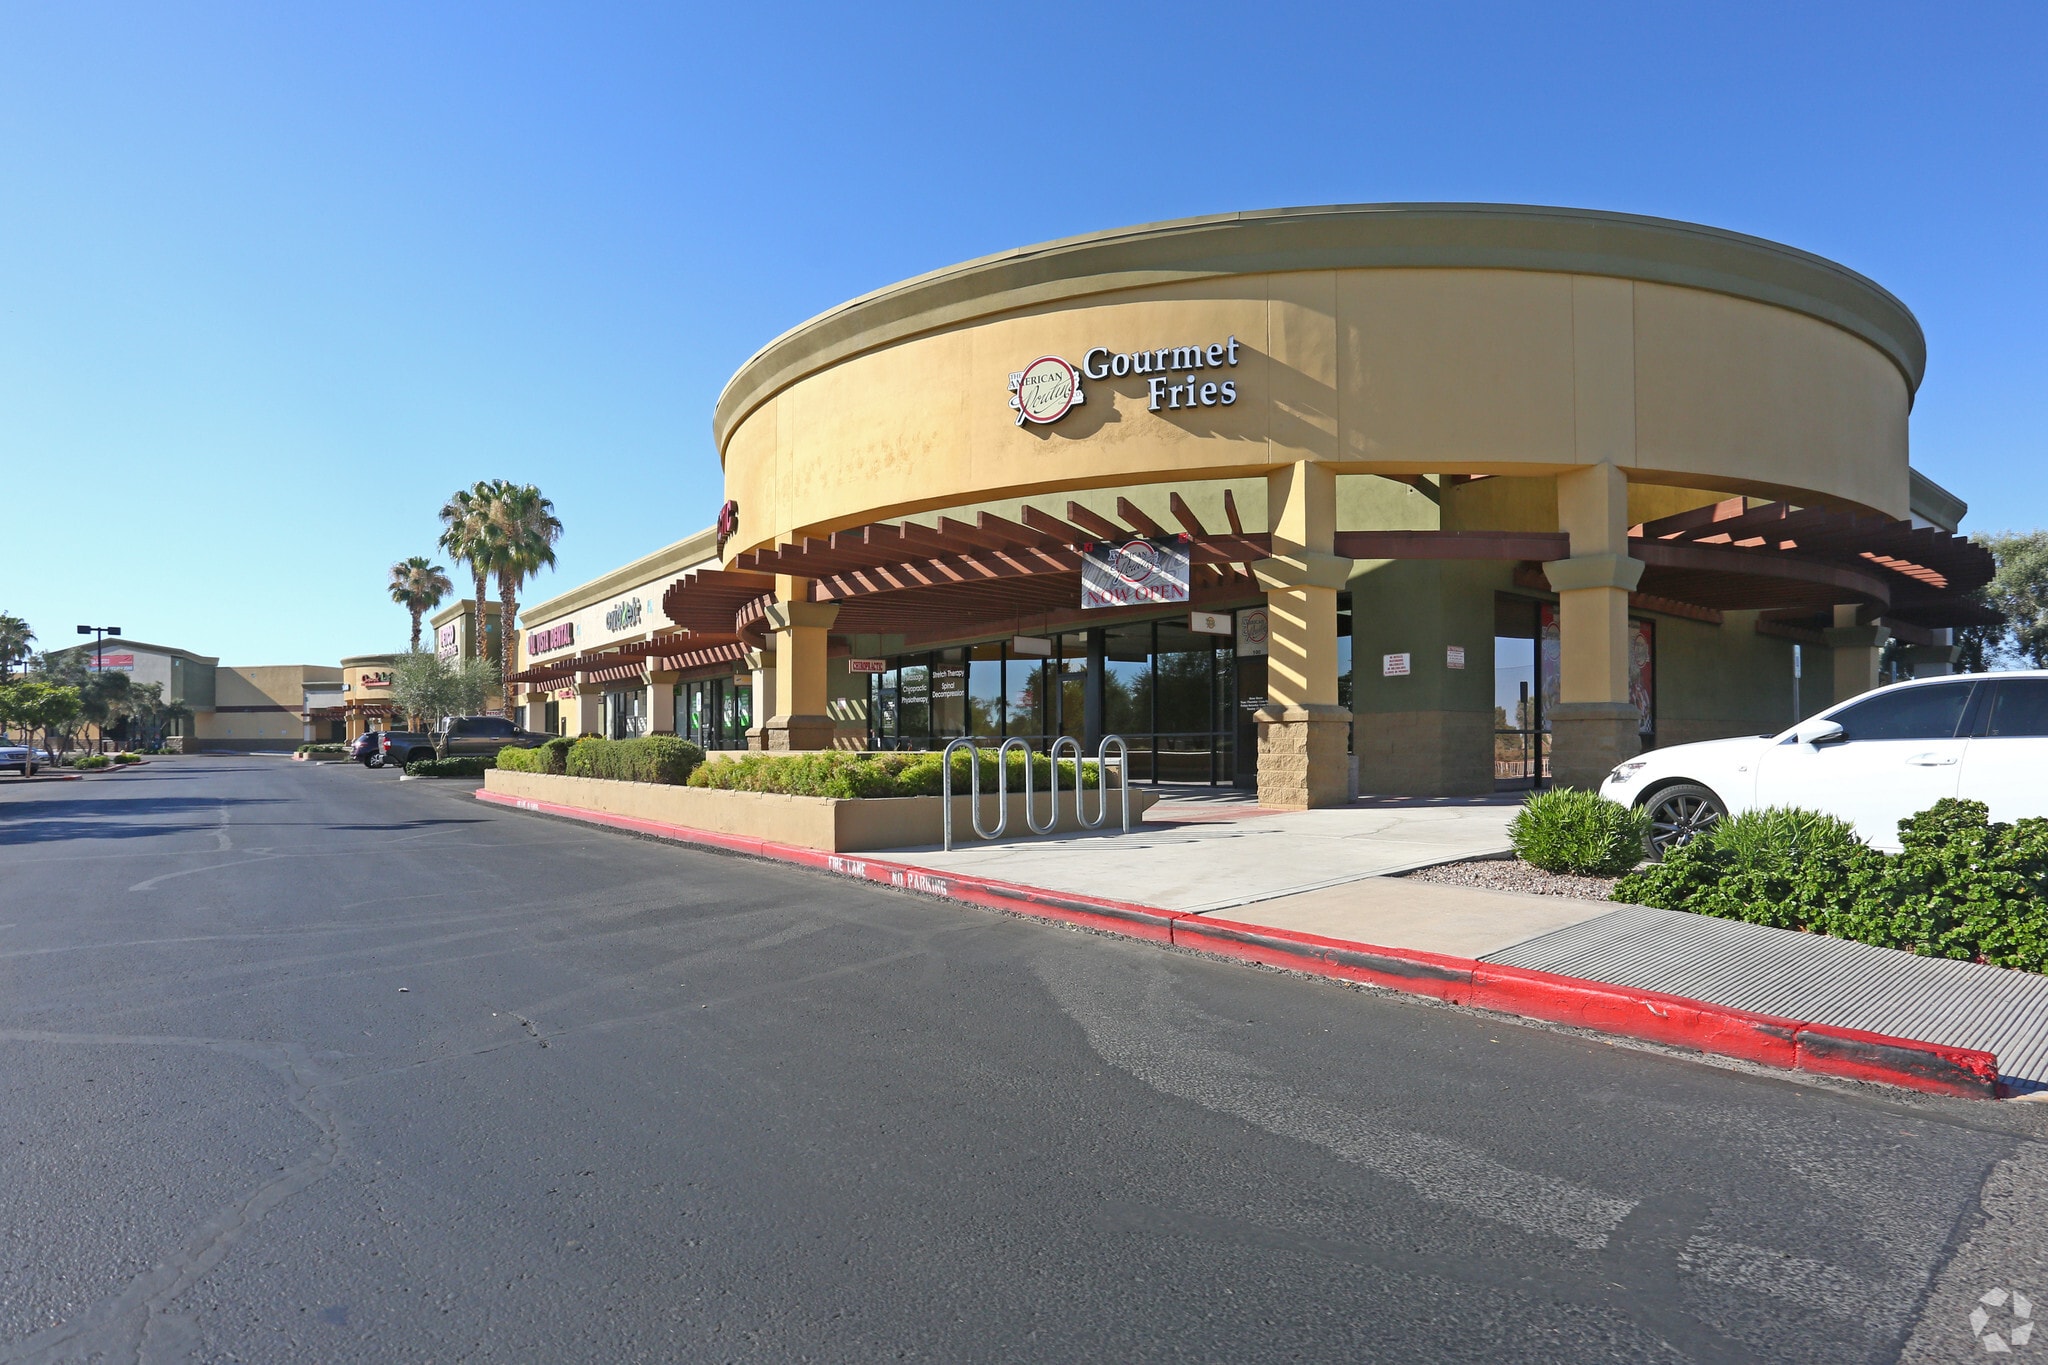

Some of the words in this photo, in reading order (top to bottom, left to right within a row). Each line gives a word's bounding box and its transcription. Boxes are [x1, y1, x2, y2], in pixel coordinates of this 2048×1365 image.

[1083, 335, 1239, 379] Gourmet
[1009, 371, 1063, 389] AMERICAN
[1147, 374, 1237, 411] Fries
[1088, 588, 1130, 605] NOW
[1135, 584, 1184, 601] OPEN
[537, 628, 549, 654] VISTA
[550, 622, 574, 651] DENTAL
[853, 661, 883, 671] CHIROPRACTIC
[947, 669, 965, 679] Therapy
[932, 689, 964, 698] Decompression
[941, 682, 955, 690] Spinal
[828, 856, 843, 872] FIRE
[847, 860, 866, 877] LANE
[891, 872, 904, 886] NO
[907, 874, 947, 895] PARKING
